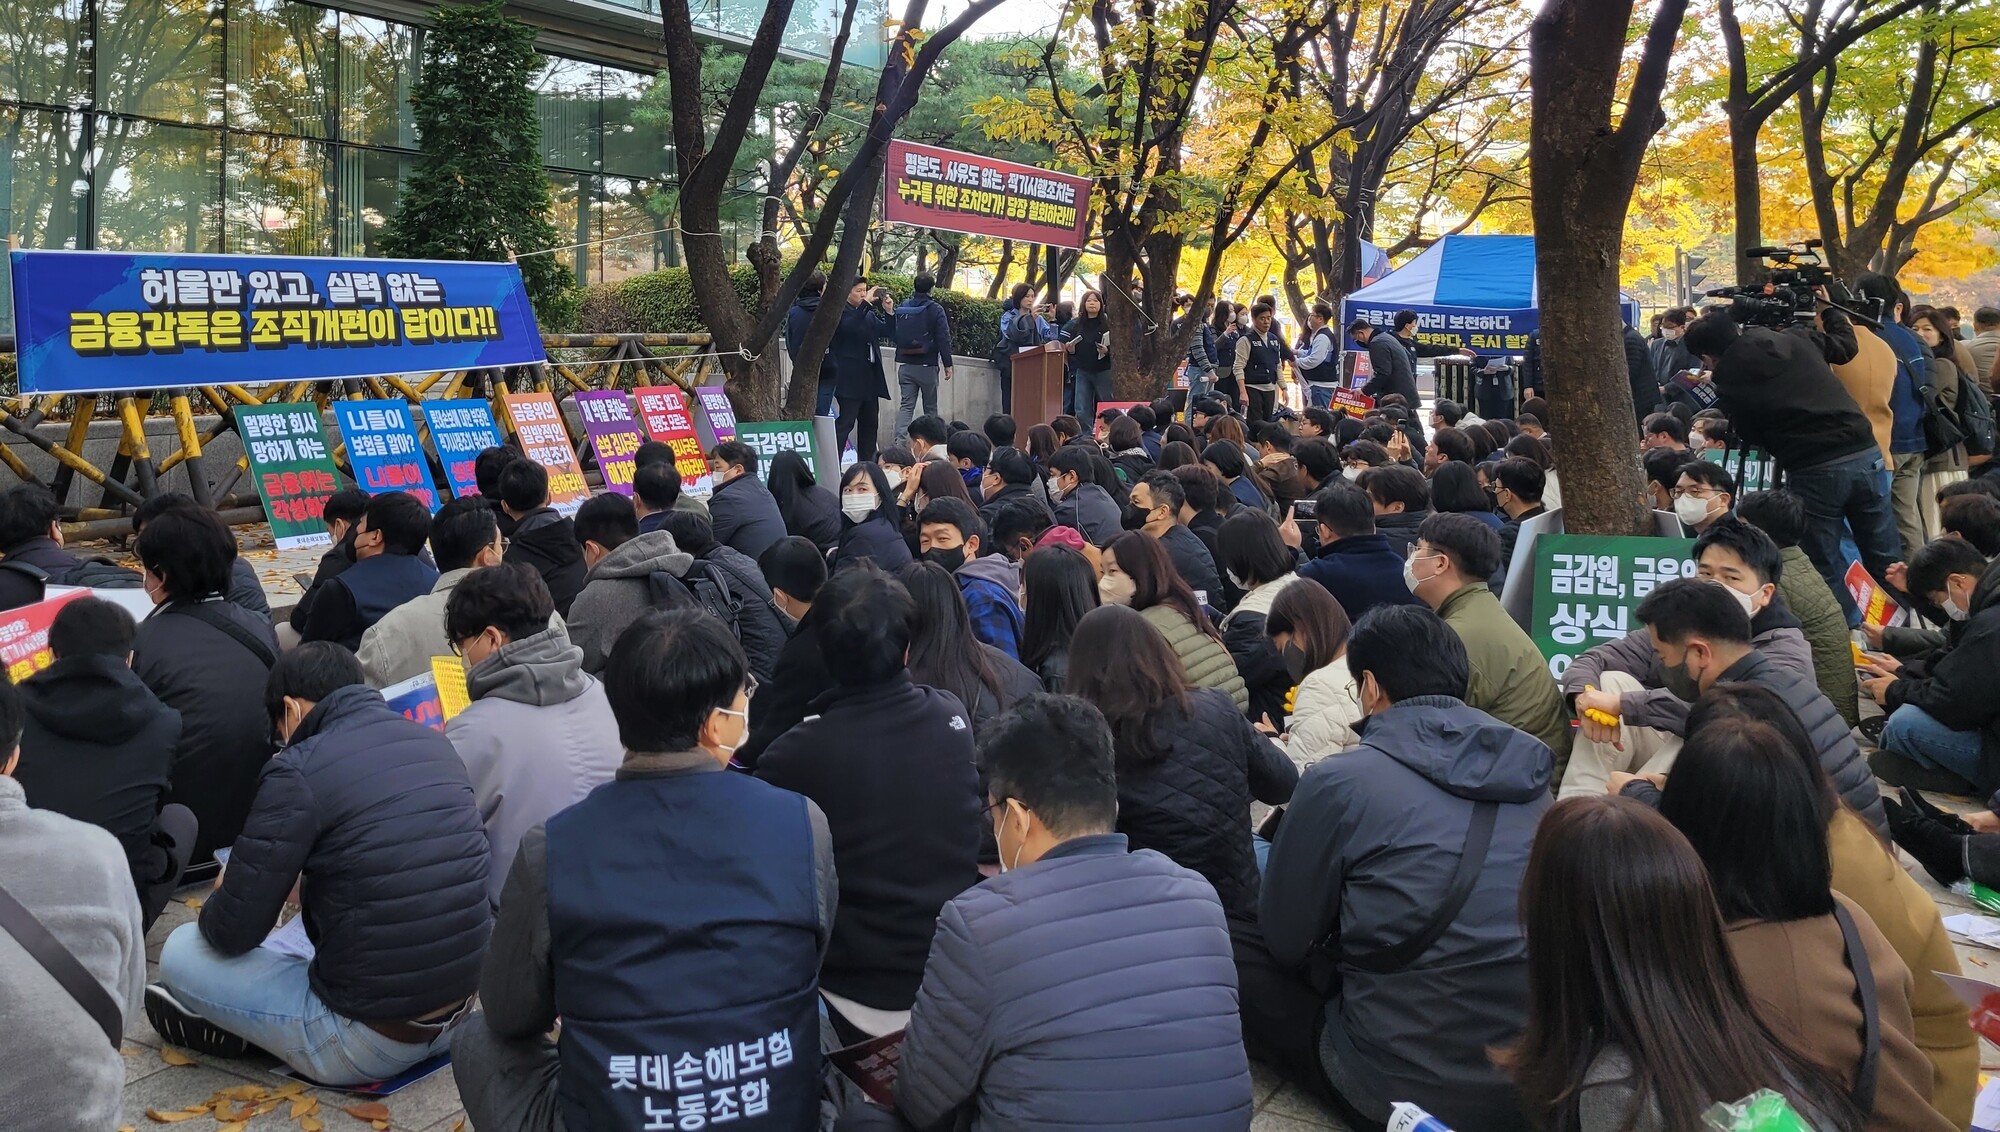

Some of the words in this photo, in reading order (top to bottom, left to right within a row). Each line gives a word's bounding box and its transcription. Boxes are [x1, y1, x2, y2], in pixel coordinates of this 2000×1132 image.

[905, 153, 943, 180] 명분도,
[946, 161, 980, 185] 사유도
[981, 168, 1005, 191] 없는,
[898, 178, 933, 204] 누구를
[935, 185, 958, 207] 위한
[959, 189, 1004, 215] 조치인가!
[1007, 196, 1028, 218] 당장
[1029, 201, 1077, 228] 철회하라!!!
[141, 269, 242, 304] 허울만
[249, 271, 319, 304] 있고,
[327, 272, 383, 304] 실력
[387, 273, 441, 302] 없는
[70, 311, 242, 349] 금융감독은
[251, 309, 395, 343] 조직개편이
[400, 307, 497, 338] 답이다!!
[1449, 315, 1511, 330] 보전하다
[1470, 334, 1501, 349] 즉시
[511, 401, 558, 422] 금융위의
[580, 400, 594, 423] 제
[591, 399, 611, 423] 역할
[605, 398, 632, 421] 못하는
[641, 395, 666, 412] 실력도
[663, 394, 684, 411] 없고,
[702, 394, 727, 411] 멀쩡한
[243, 413, 288, 437] 멀쩡한
[288, 412, 318, 434] 회사
[347, 409, 405, 431] 니들이
[429, 409, 462, 430] 롯데손보에
[458, 409, 474, 429] 대한
[470, 407, 491, 428] 부당한
[648, 414, 671, 433] 현장도
[668, 413, 692, 431] 모르는,
[351, 434, 388, 456] 보험을
[387, 433, 415, 455] 알아?
[520, 423, 566, 445] 일방적인
[596, 434, 615, 458] 손보
[251, 439, 297, 464] 망하게
[296, 437, 327, 460] 하는
[528, 445, 574, 466] 행정조치
[262, 469, 337, 497] 금융위는
[365, 463, 423, 487] 니들이
[549, 472, 585, 495] 성하라!!
[605, 460, 637, 485] 해체하
[1551, 554, 1626, 600] 금감원,
[608, 1028, 794, 1090] 롯데손해보험
[644, 1077, 771, 1132] 노동조합
